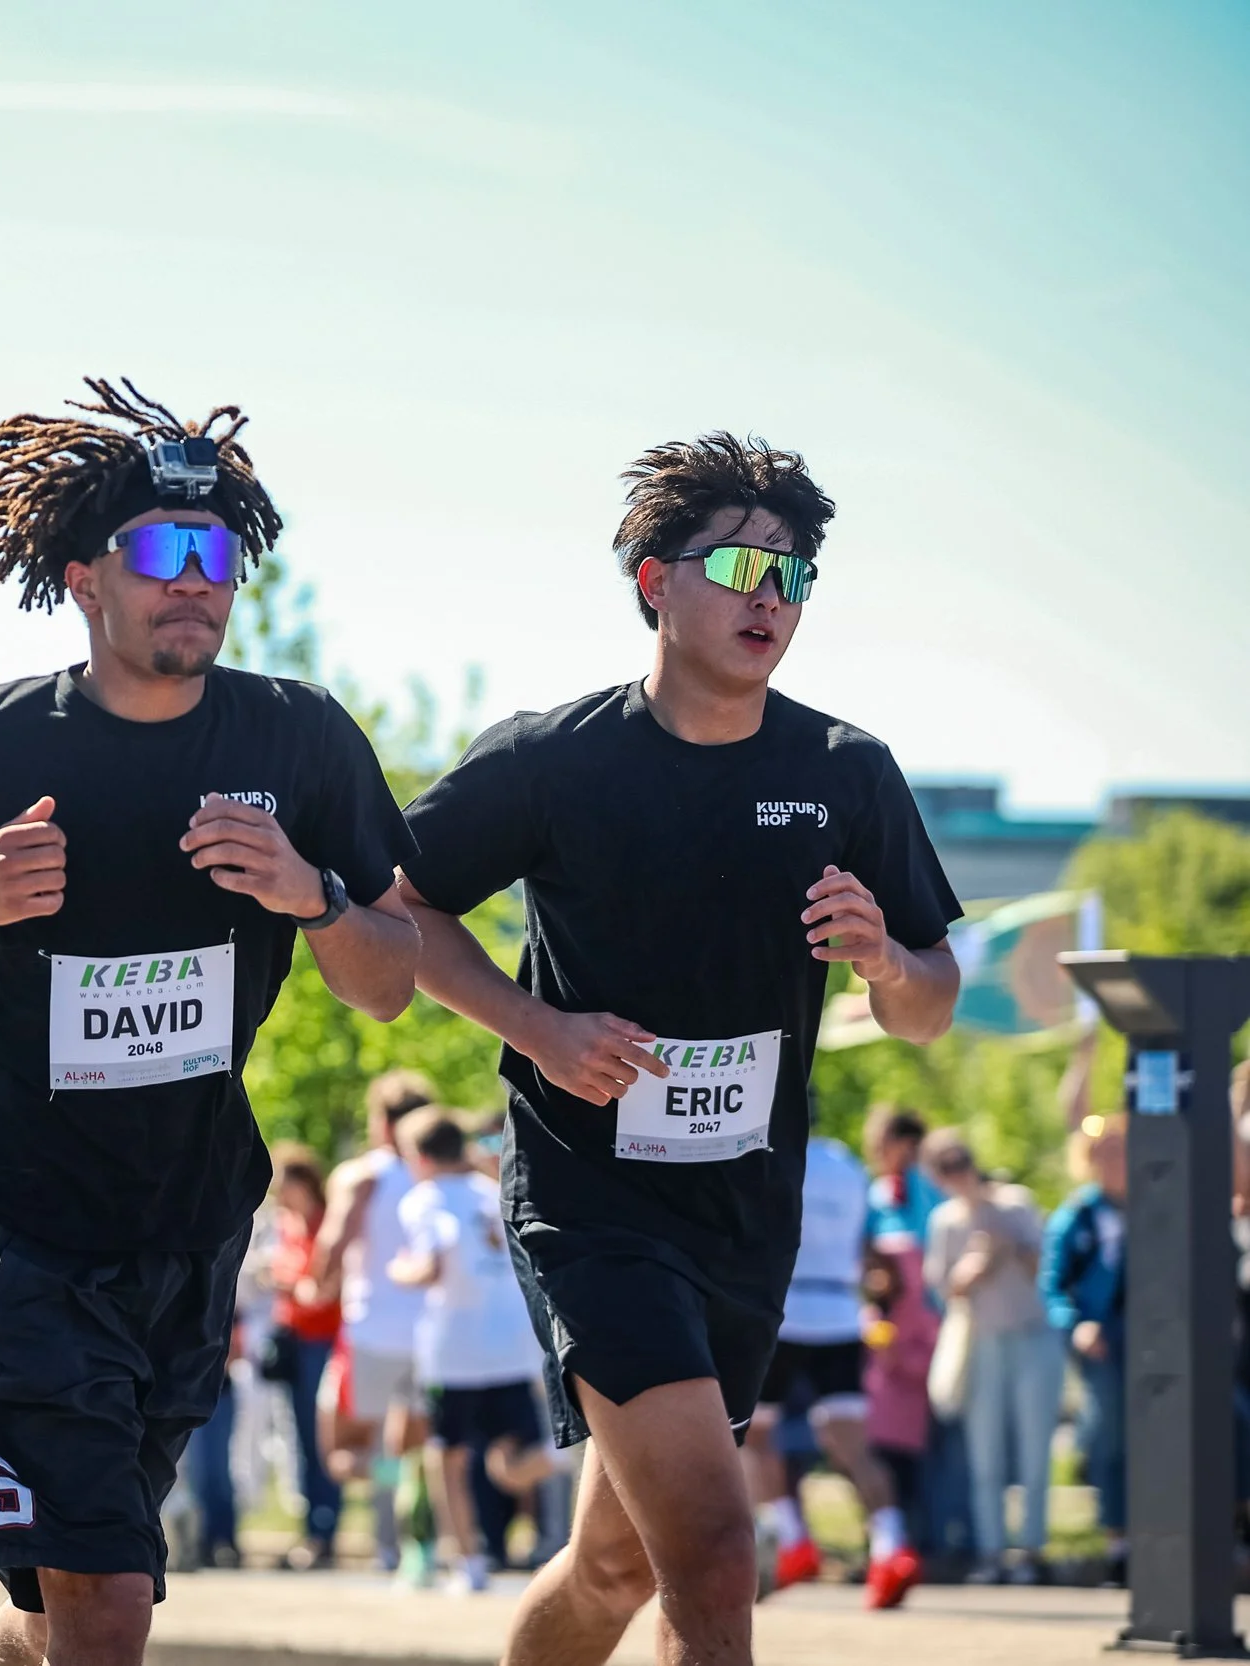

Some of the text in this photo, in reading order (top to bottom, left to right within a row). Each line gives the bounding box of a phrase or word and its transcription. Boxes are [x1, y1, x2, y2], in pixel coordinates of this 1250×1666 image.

[756, 801, 817, 814] KULTUR
[756, 813, 791, 826] HOF
[79, 956, 204, 988] KEBA
[79, 981, 204, 999] www.keba.com
[83, 998, 203, 1040] DAVID
[127, 1041, 163, 1057] 2048
[653, 1041, 757, 1068] KEBA
[183, 1054, 212, 1067] KULTUR
[183, 1063, 199, 1073] HOF
[665, 1083, 744, 1117] ERIC
[689, 1121, 721, 1134] 2047
